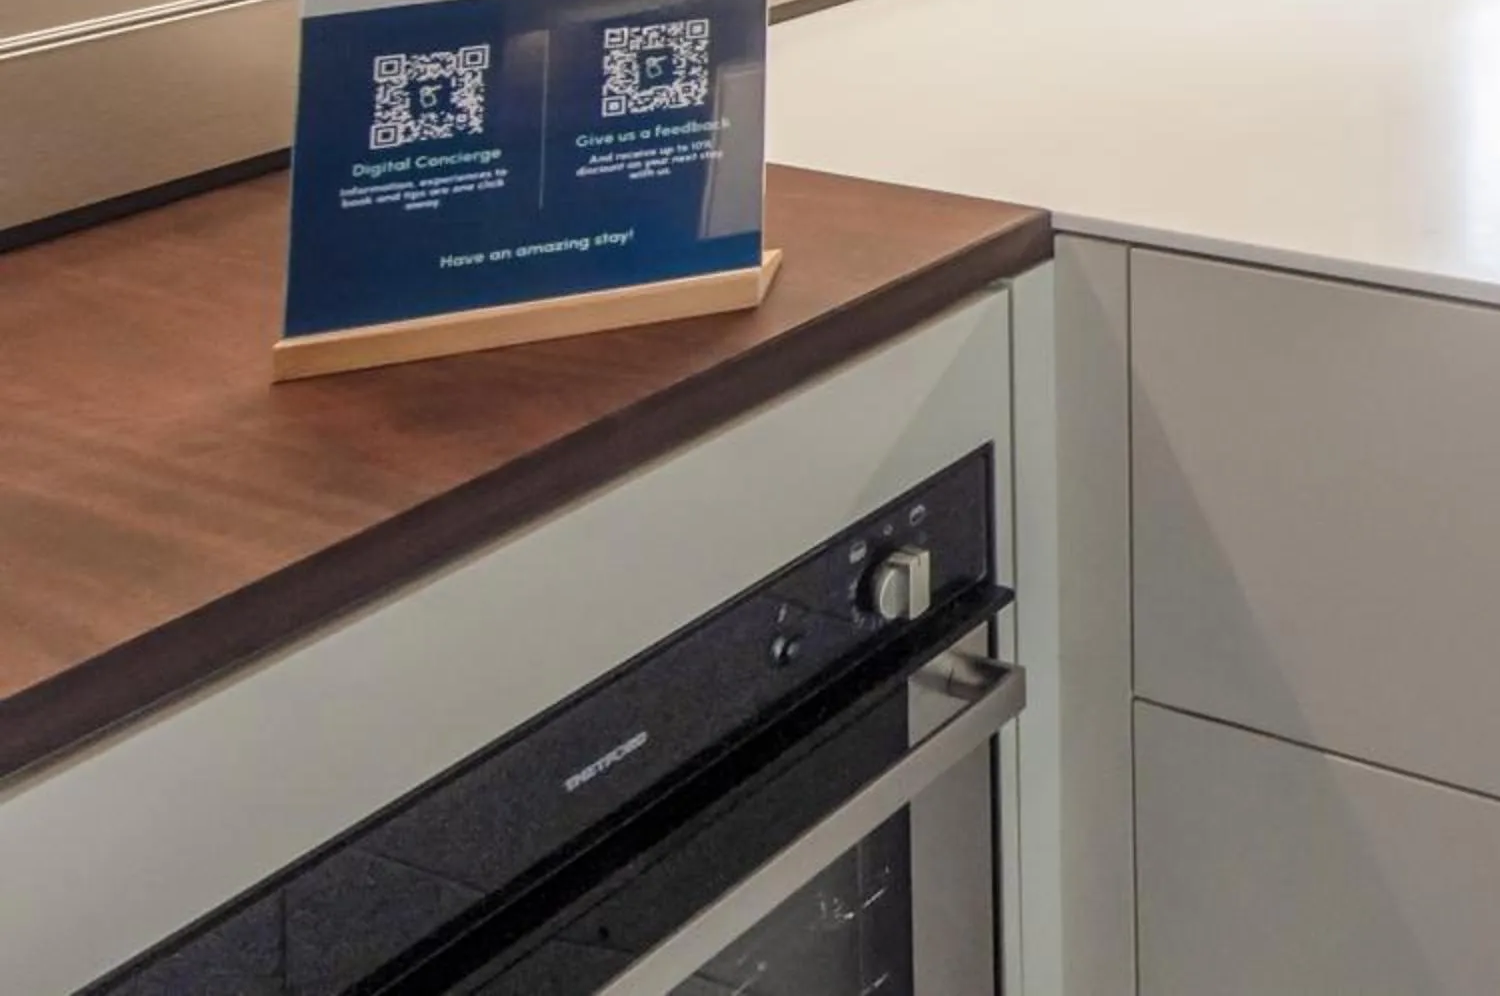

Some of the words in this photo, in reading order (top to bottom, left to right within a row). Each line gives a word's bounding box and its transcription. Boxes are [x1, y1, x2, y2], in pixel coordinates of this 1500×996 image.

[575, 133, 615, 148] Give
[617, 130, 636, 143] us
[640, 129, 651, 140] a
[352, 158, 411, 178] Digital
[415, 149, 502, 169] Concierge
[439, 253, 485, 268] Have
[489, 249, 513, 261] an
[515, 235, 590, 256] amazing
[594, 227, 634, 245] stay!
